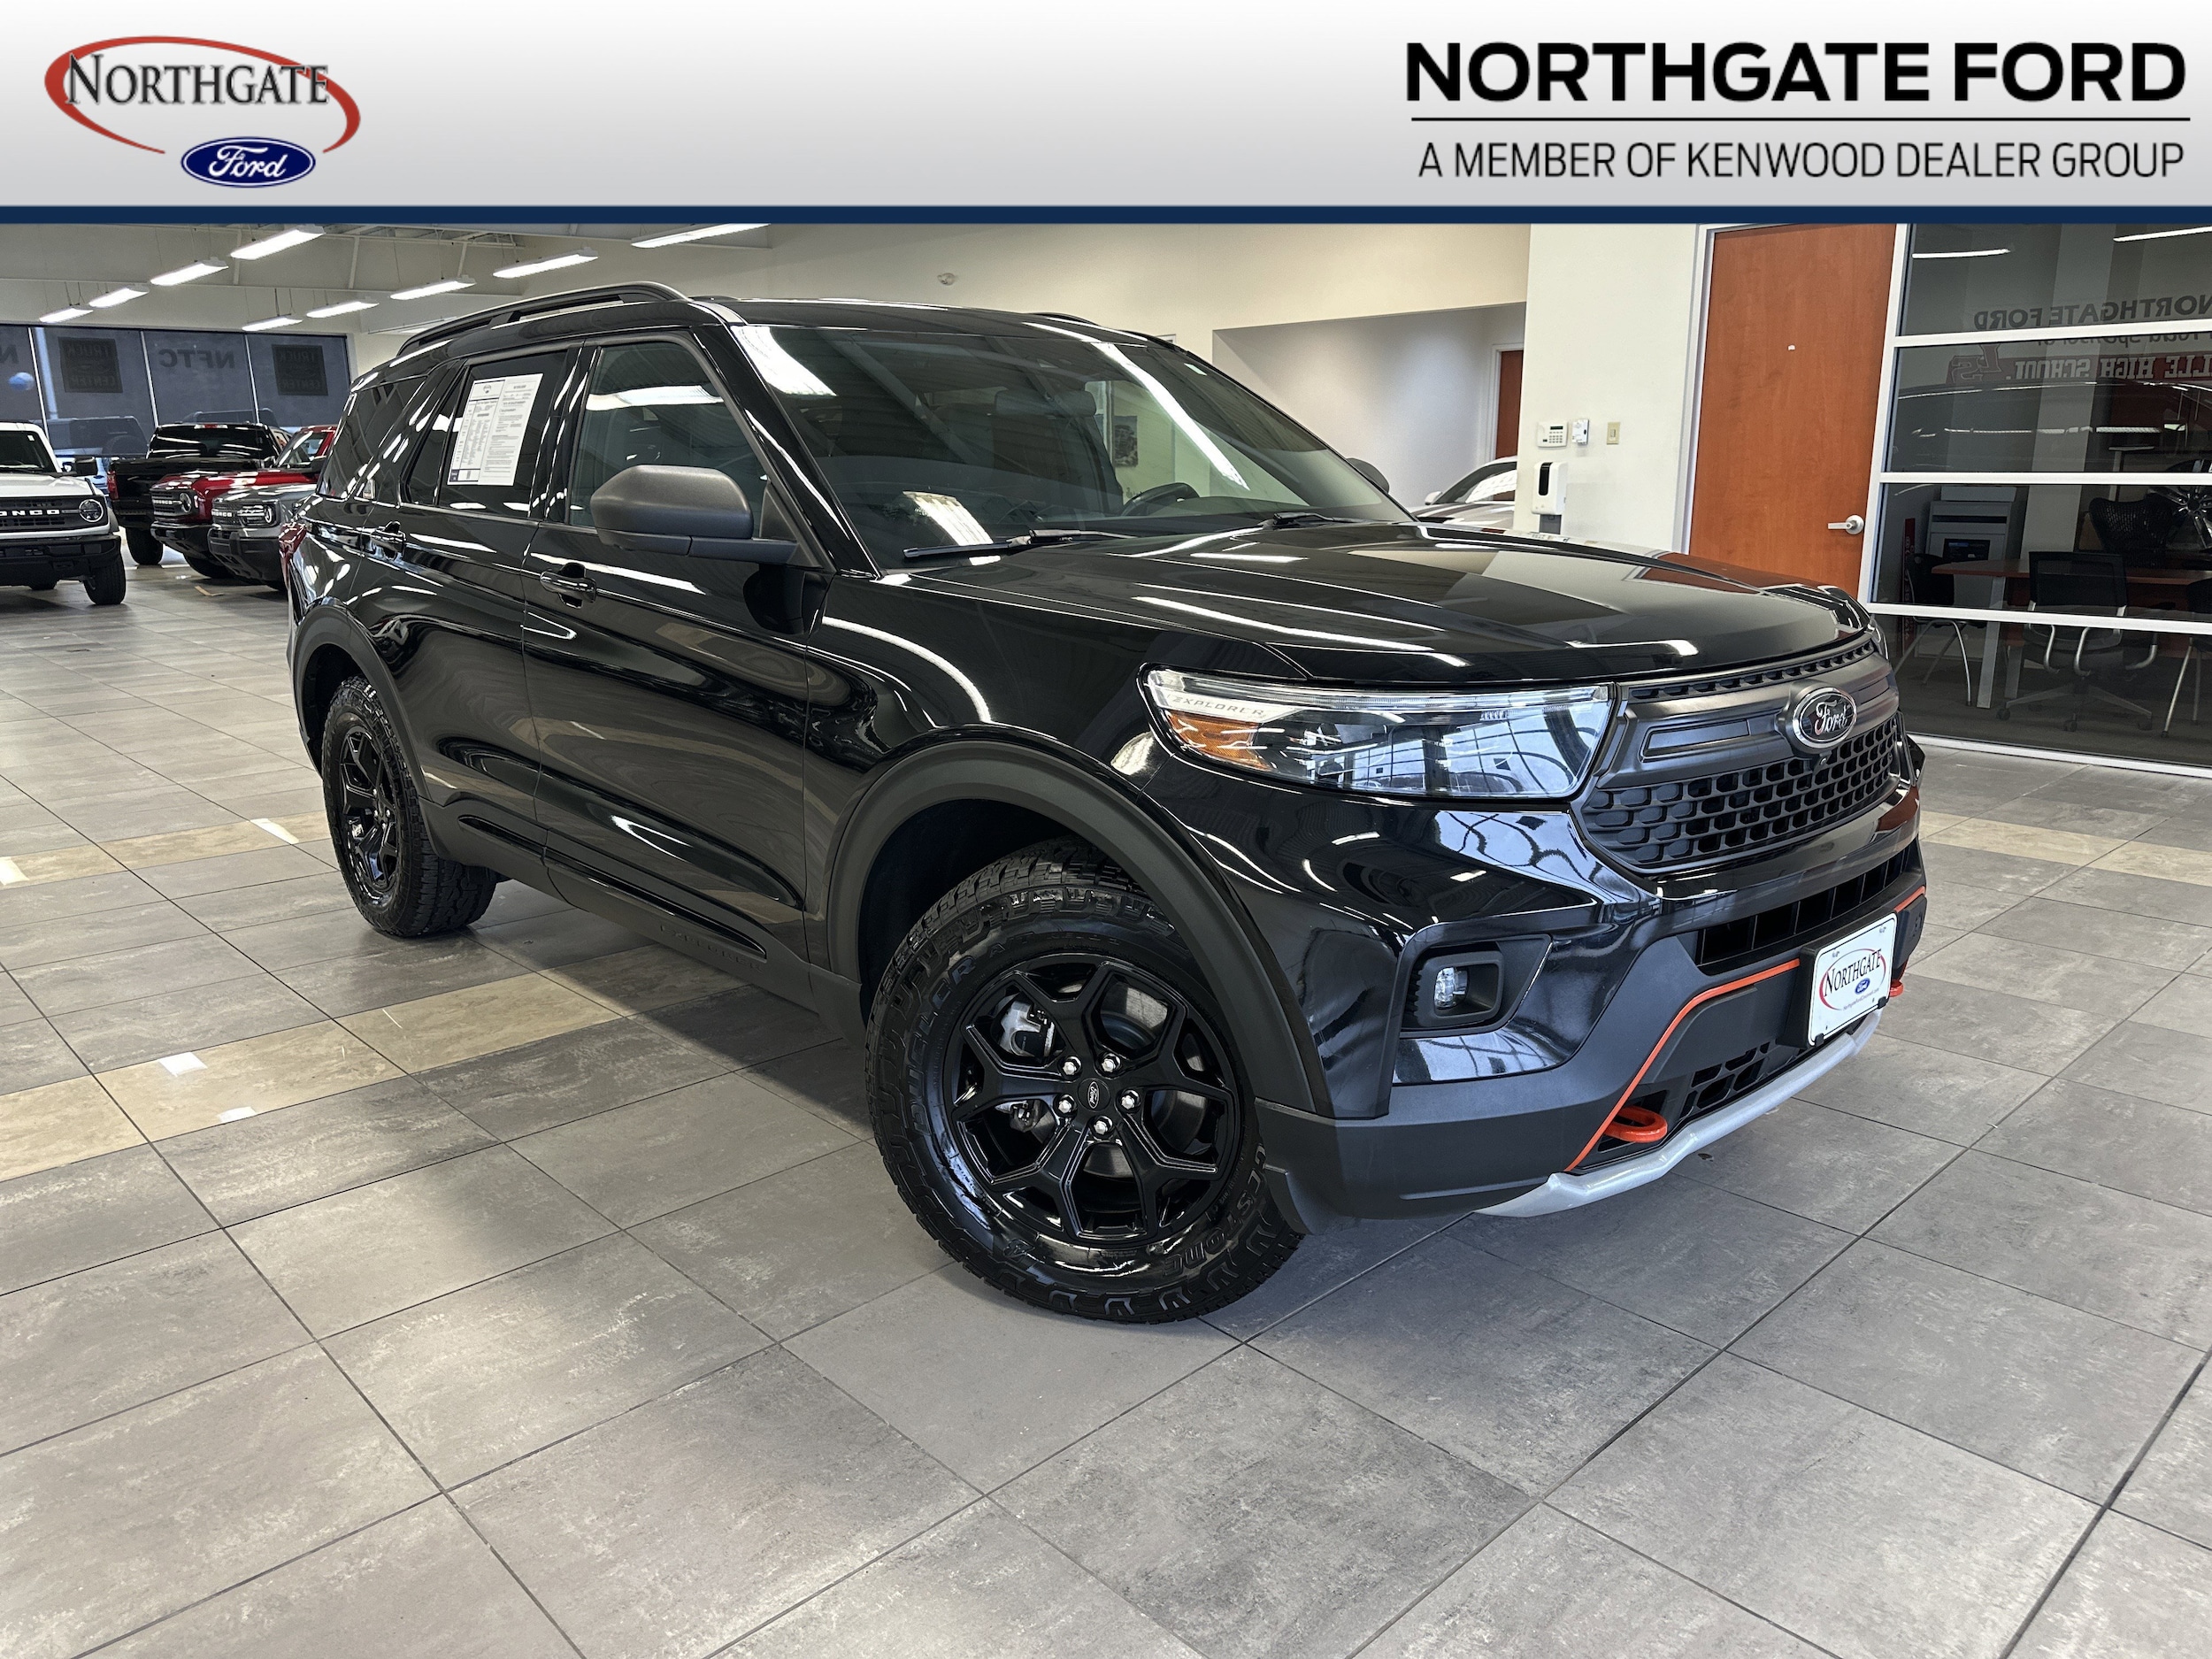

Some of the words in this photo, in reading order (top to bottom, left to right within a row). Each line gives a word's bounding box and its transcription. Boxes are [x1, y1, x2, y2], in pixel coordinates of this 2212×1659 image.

[1171, 695, 1265, 716] EXPLORER
[1814, 699, 1849, 736] Ford
[659, 924, 764, 972] EXPLORER
[1824, 948, 1882, 997] NORTHGATE
